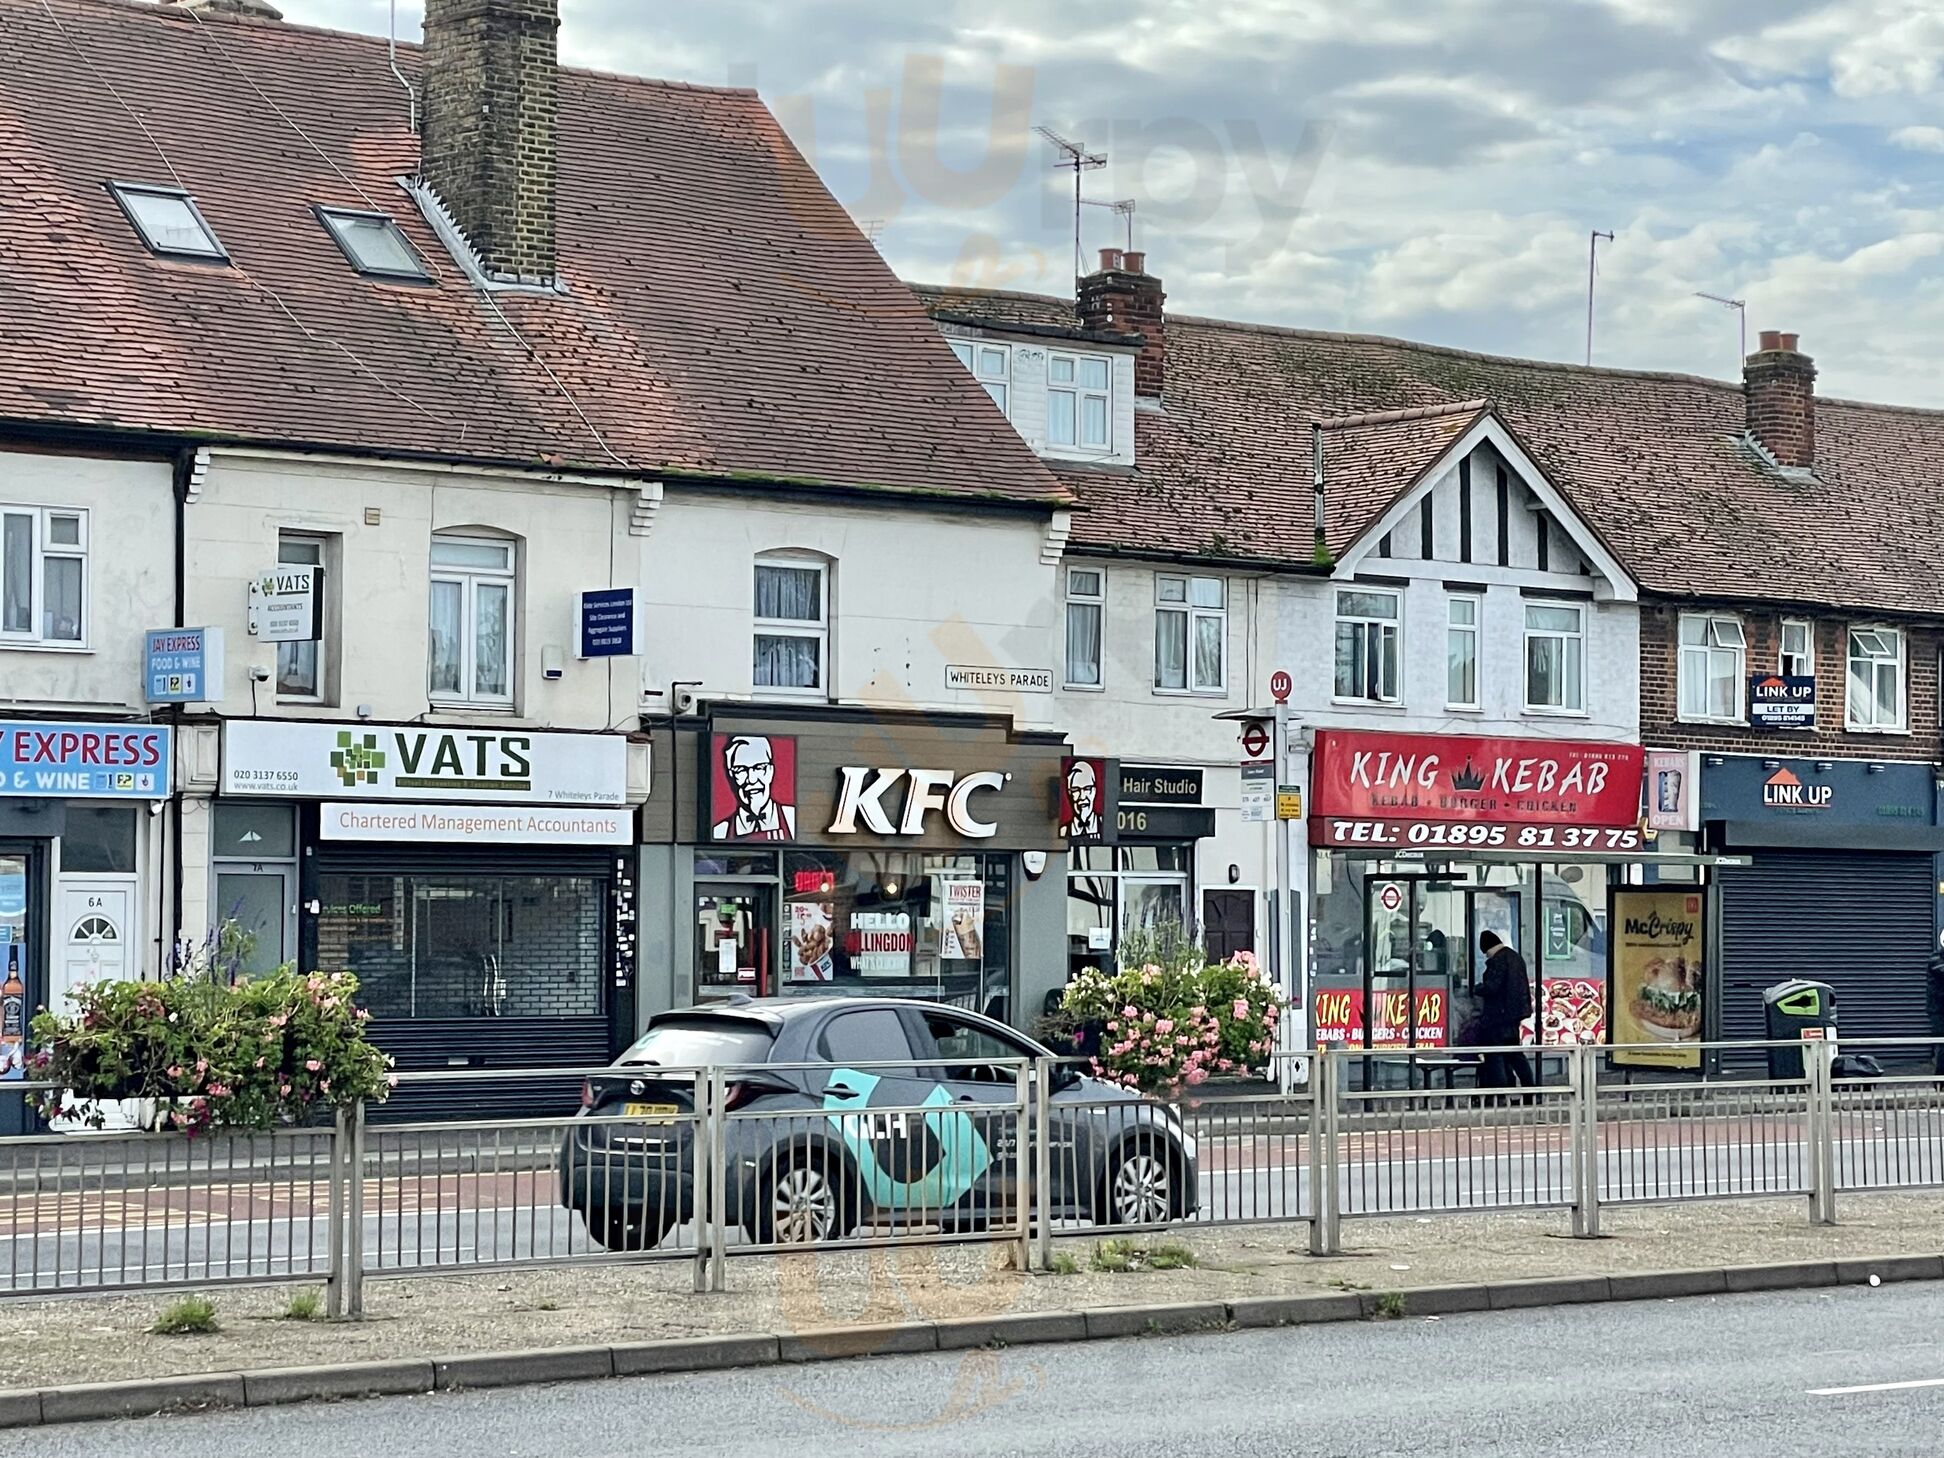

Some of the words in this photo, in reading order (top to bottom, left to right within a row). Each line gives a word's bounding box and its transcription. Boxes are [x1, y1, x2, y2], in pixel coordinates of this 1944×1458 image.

[277, 575, 310, 590] VATS
[167, 635, 200, 652] EXPRESS
[152, 657, 173, 670] FOOD
[174, 657, 181, 669] &
[182, 656, 200, 669] WINE
[950, 671, 1006, 685] WHITELEYS
[1010, 674, 1049, 687] PARADE
[1272, 678, 1287, 691] UJ
[1756, 686, 1788, 697] LINK
[1792, 686, 1812, 697] UP
[14, 731, 160, 766] EXPRESS
[395, 732, 531, 777] VATS
[13, 771, 30, 789] &
[36, 771, 90, 790] WINE
[234, 770, 250, 779] 020
[253, 770, 274, 780] 3137
[276, 771, 299, 781] 6550
[1350, 751, 1440, 789] KING
[1491, 757, 1609, 796] KEBAB
[234, 782, 298, 791] www.vats.co.uk
[1123, 777, 1151, 793] Hair
[1154, 778, 1197, 794] Studio
[548, 790, 553, 799] 7
[555, 790, 592, 801] Whiteleys
[594, 792, 620, 801] Parade
[828, 766, 1004, 838] KFC
[1763, 784, 1803, 804] LINK
[1808, 786, 1833, 804] UP
[1371, 793, 1419, 807] KEBAB
[1440, 795, 1497, 811] BURGER
[1516, 799, 1577, 813] CHICKEN
[339, 811, 417, 829] Chartered
[421, 813, 522, 834] Management
[526, 815, 617, 834] Accountants
[1652, 815, 1684, 826] OPEN
[1333, 821, 1401, 843] TEL:
[1407, 823, 1507, 845] 01895
[1517, 826, 1555, 847] 81
[1561, 828, 1599, 848] 37
[1603, 829, 1639, 849] 75
[252, 863, 264, 872] 7A
[949, 884, 981, 898] TWISTER
[88, 896, 103, 908] 6A
[349, 904, 381, 914] Offered
[850, 912, 910, 930] HELLO
[1624, 912, 1694, 945] McCrispy
[1386, 993, 1441, 1027] KEAB
[1316, 1028, 1346, 1041] EBABS
[1351, 1028, 1395, 1041] BUGERS
[1401, 1027, 1443, 1040] CICKEN
